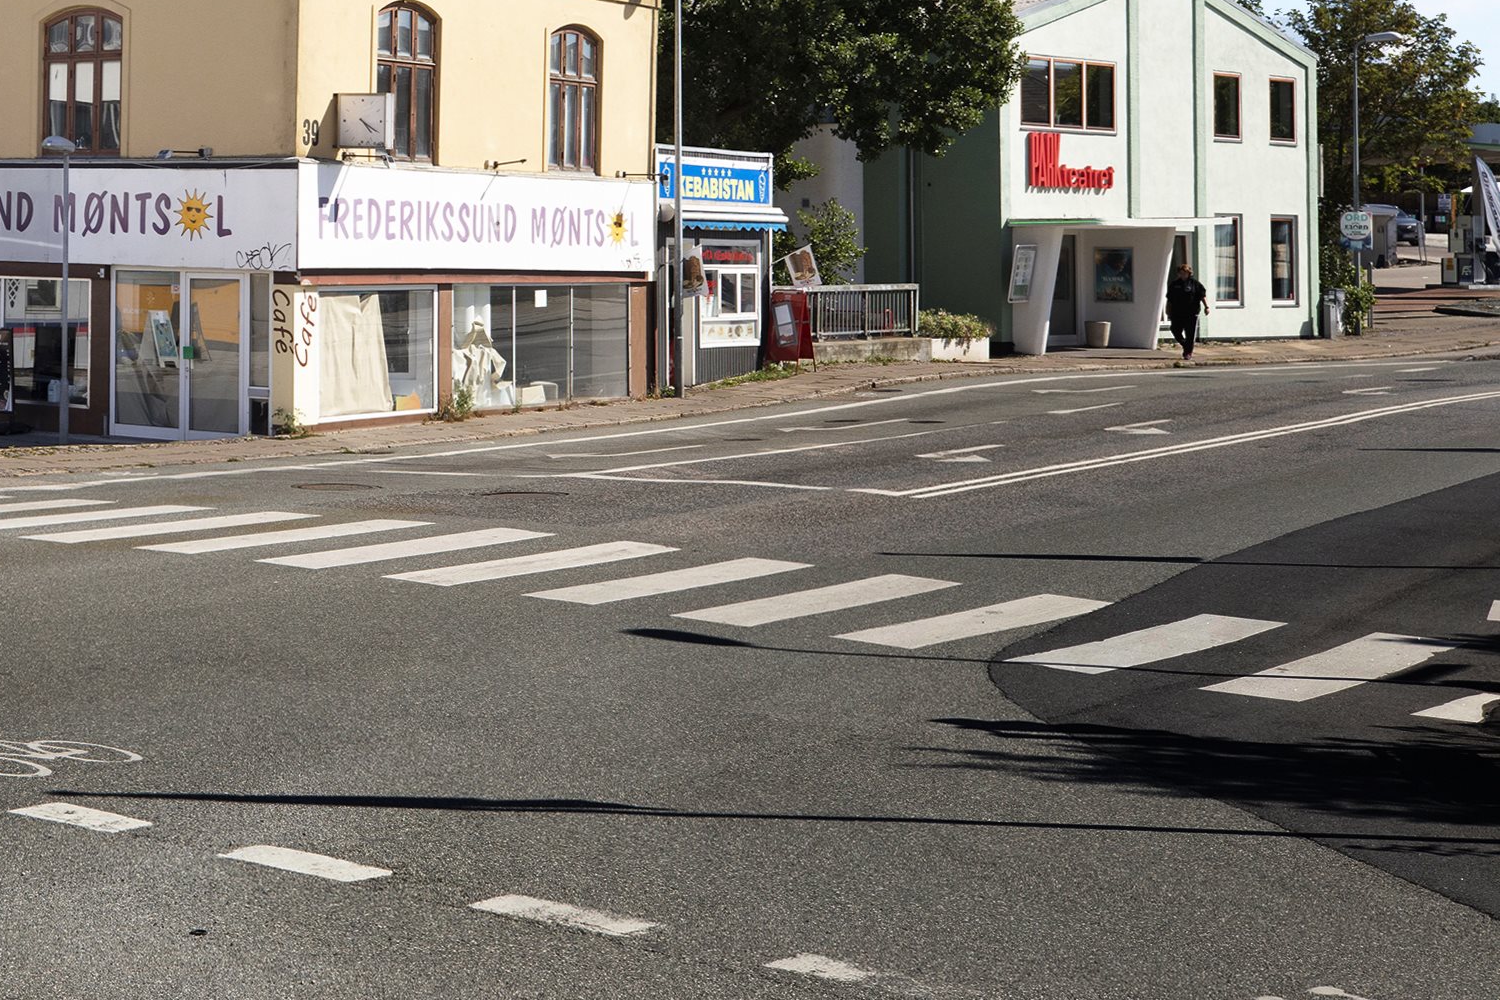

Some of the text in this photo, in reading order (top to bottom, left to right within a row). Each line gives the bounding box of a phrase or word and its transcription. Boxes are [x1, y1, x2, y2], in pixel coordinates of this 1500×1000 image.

[302, 118, 319, 146] 39
[318, 196, 517, 243] FREDERIKSSUND
[272, 289, 294, 354] Café
[295, 289, 317, 367] Café
